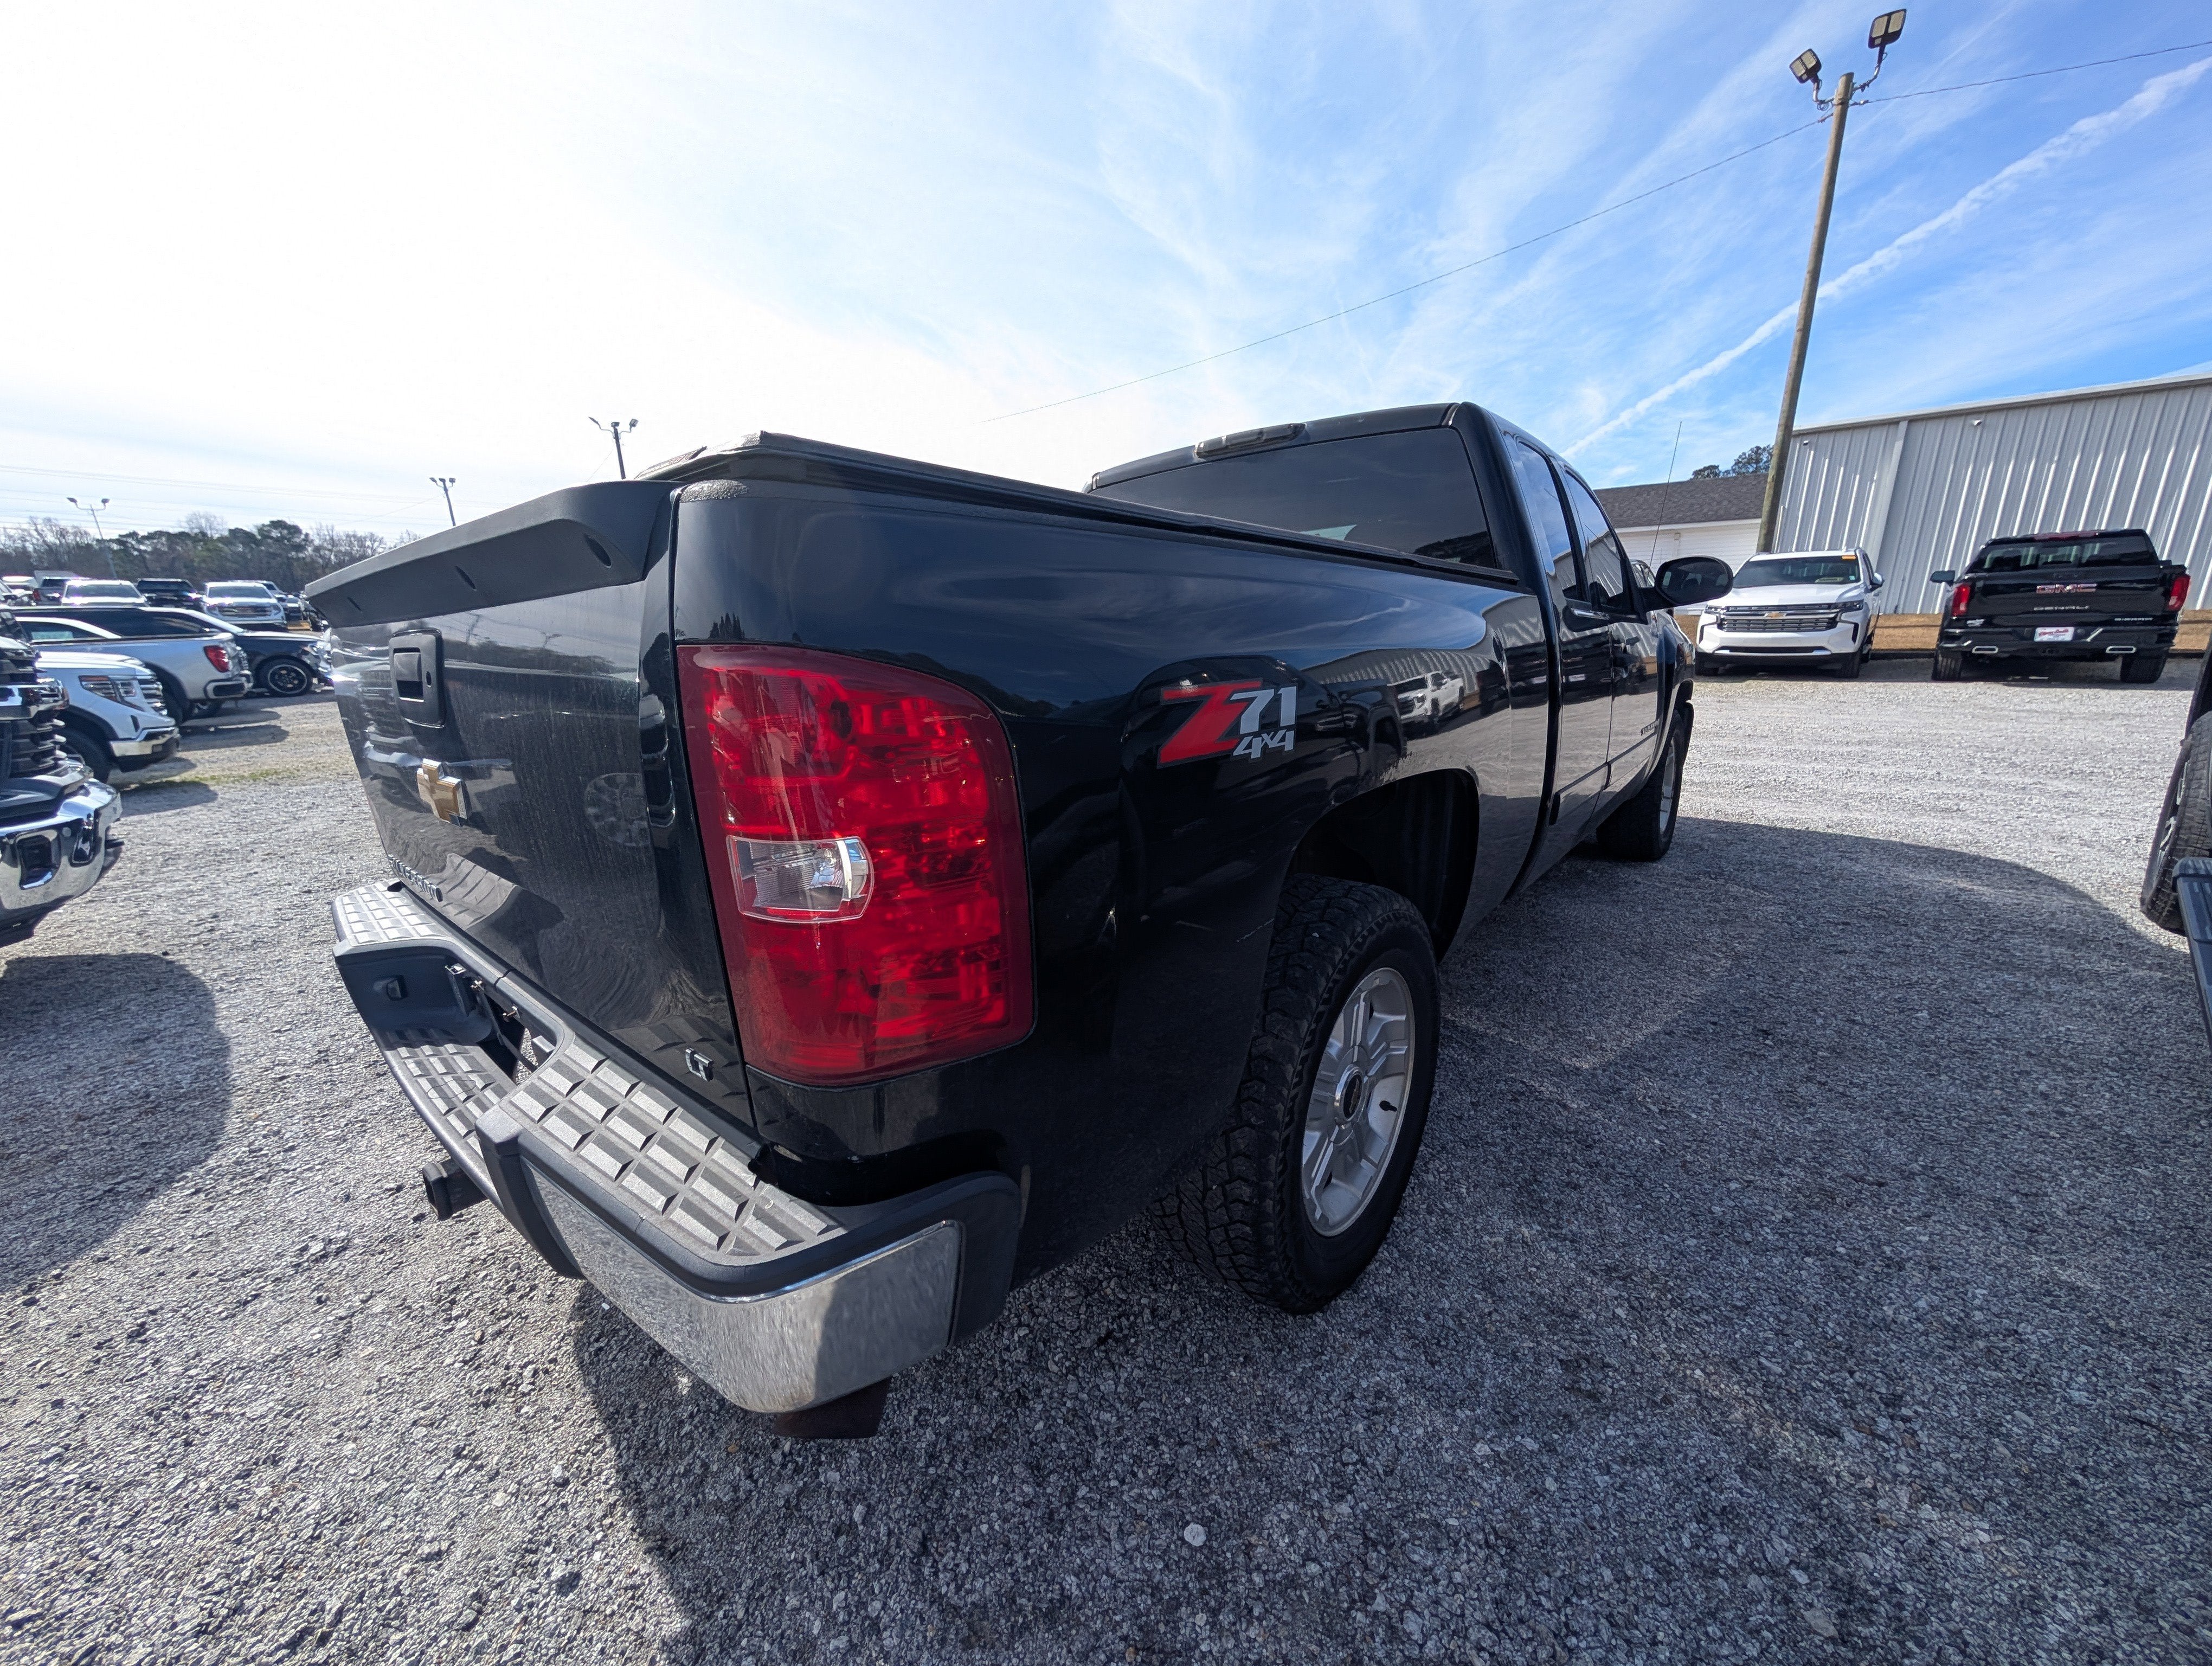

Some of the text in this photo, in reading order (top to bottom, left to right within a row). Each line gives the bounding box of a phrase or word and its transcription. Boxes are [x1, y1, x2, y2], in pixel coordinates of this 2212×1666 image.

[2036, 584, 2097, 593] GMC
[1159, 681, 1297, 763] Z71
[685, 1048, 712, 1081] LT
